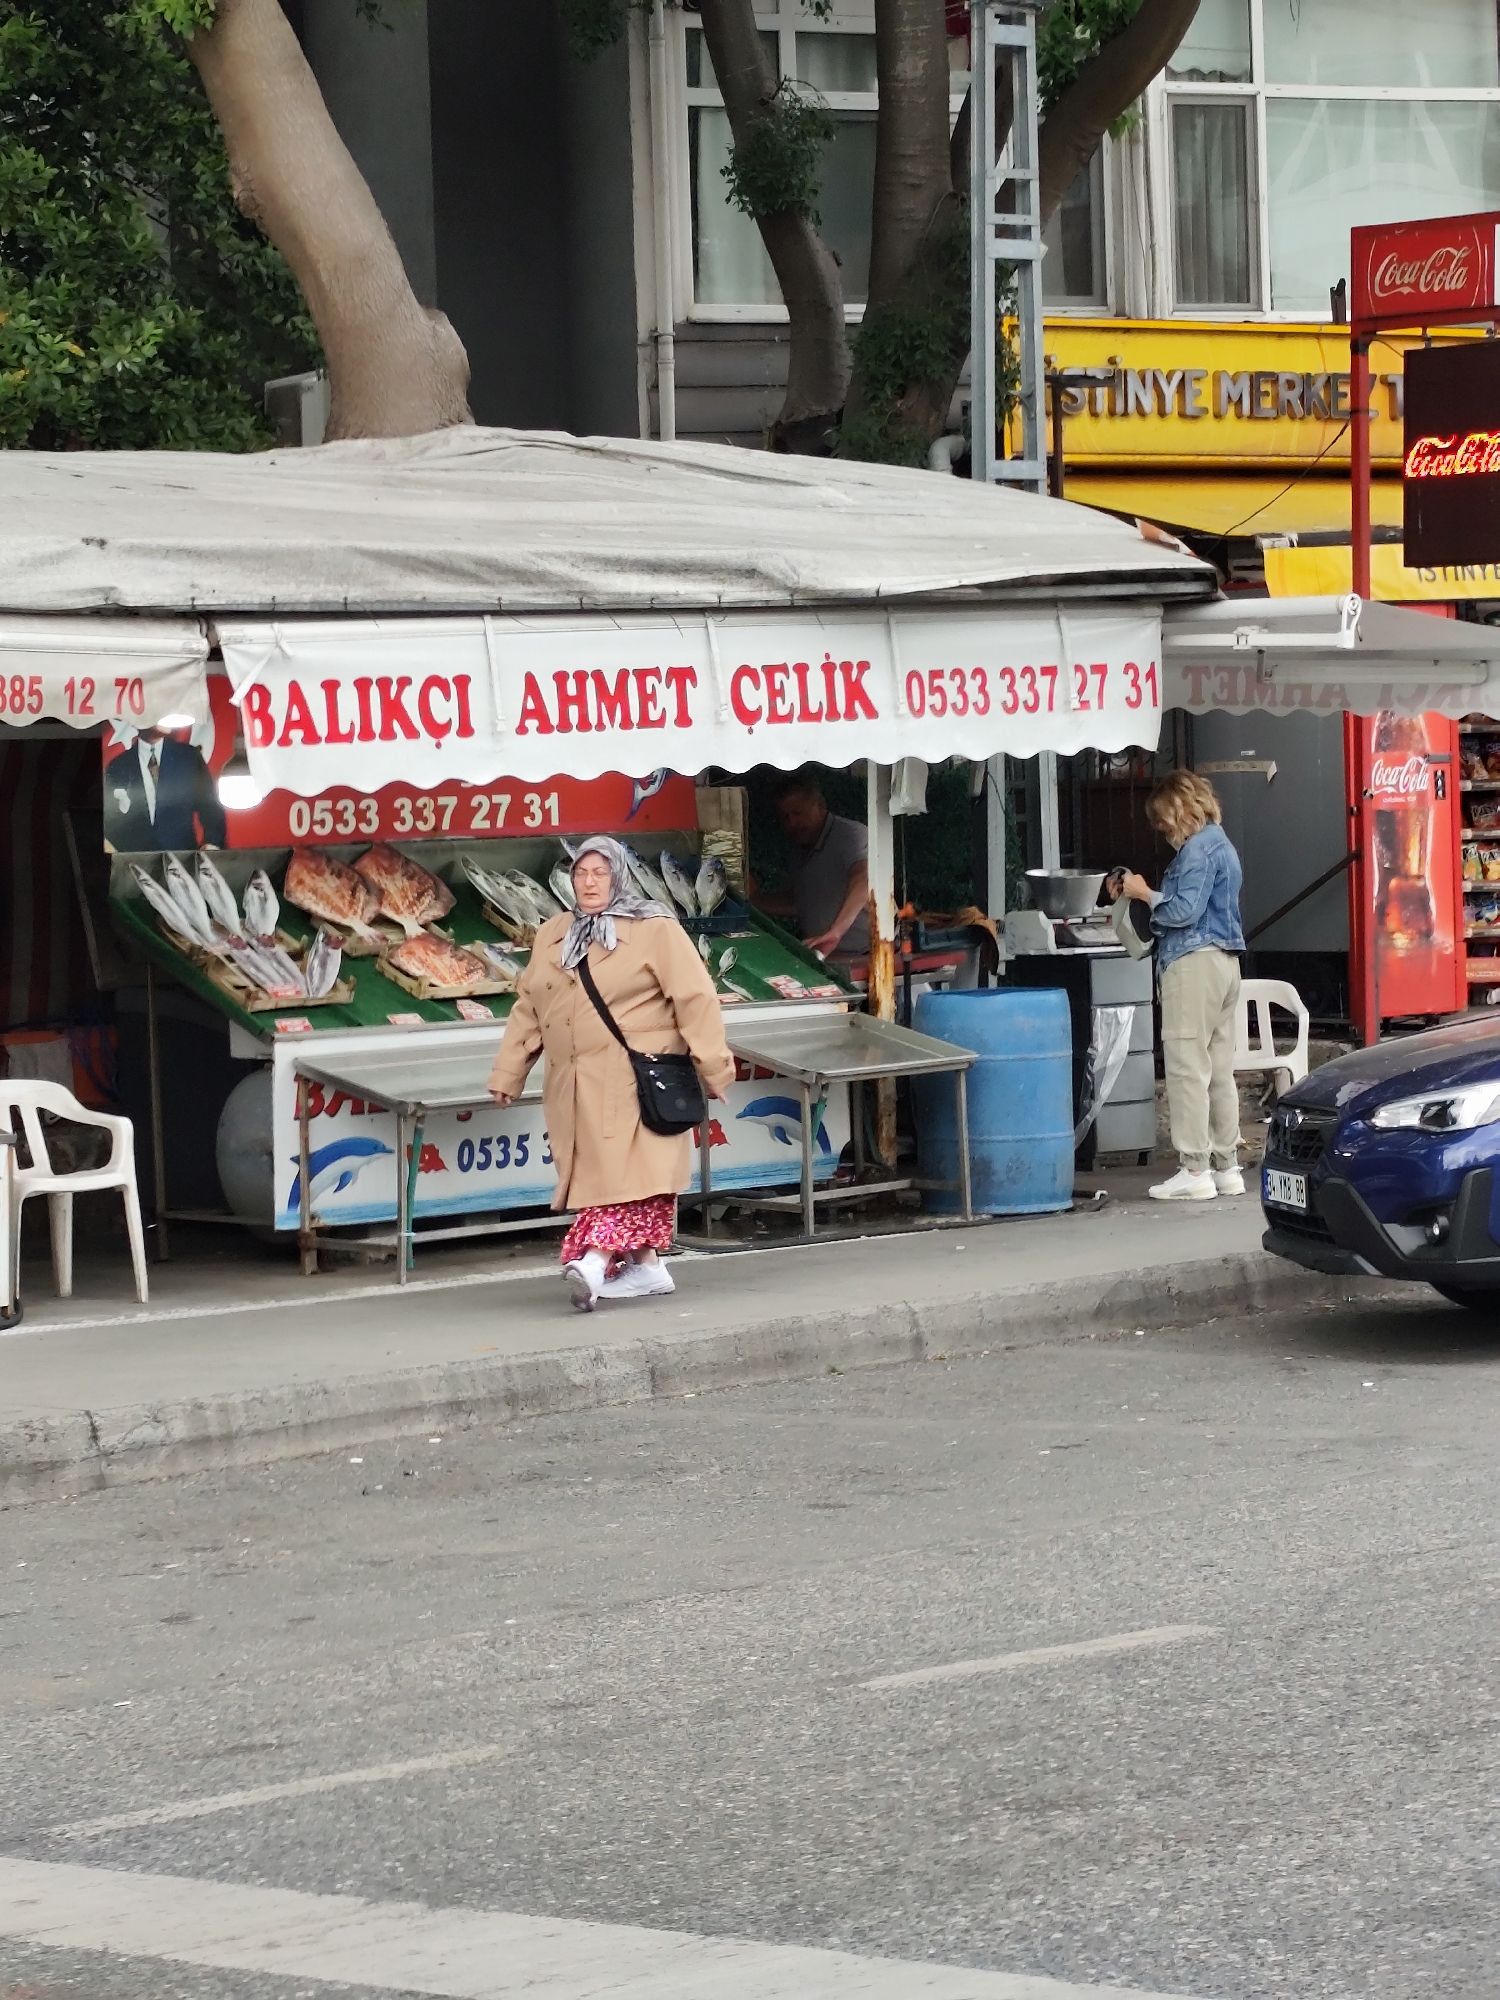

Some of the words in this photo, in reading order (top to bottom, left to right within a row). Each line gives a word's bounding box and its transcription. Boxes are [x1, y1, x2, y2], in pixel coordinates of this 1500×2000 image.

[1374, 246, 1474, 297] Coca-Cola
[63, 676, 95, 715] 12
[114, 677, 145, 716] 70
[241, 674, 475, 749] BALIKÇI
[515, 666, 698, 735] AHMET
[730, 652, 879, 735] ÇELİK
[905, 667, 991, 719] 0533
[1000, 665, 1058, 714] 337
[1073, 663, 1108, 711] 27
[1122, 661, 1158, 709] 31
[288, 799, 380, 838] 0533
[392, 796, 458, 832] 337
[470, 794, 512, 830] 27
[523, 792, 559, 827] 31
[457, 1131, 530, 1172] 0535
